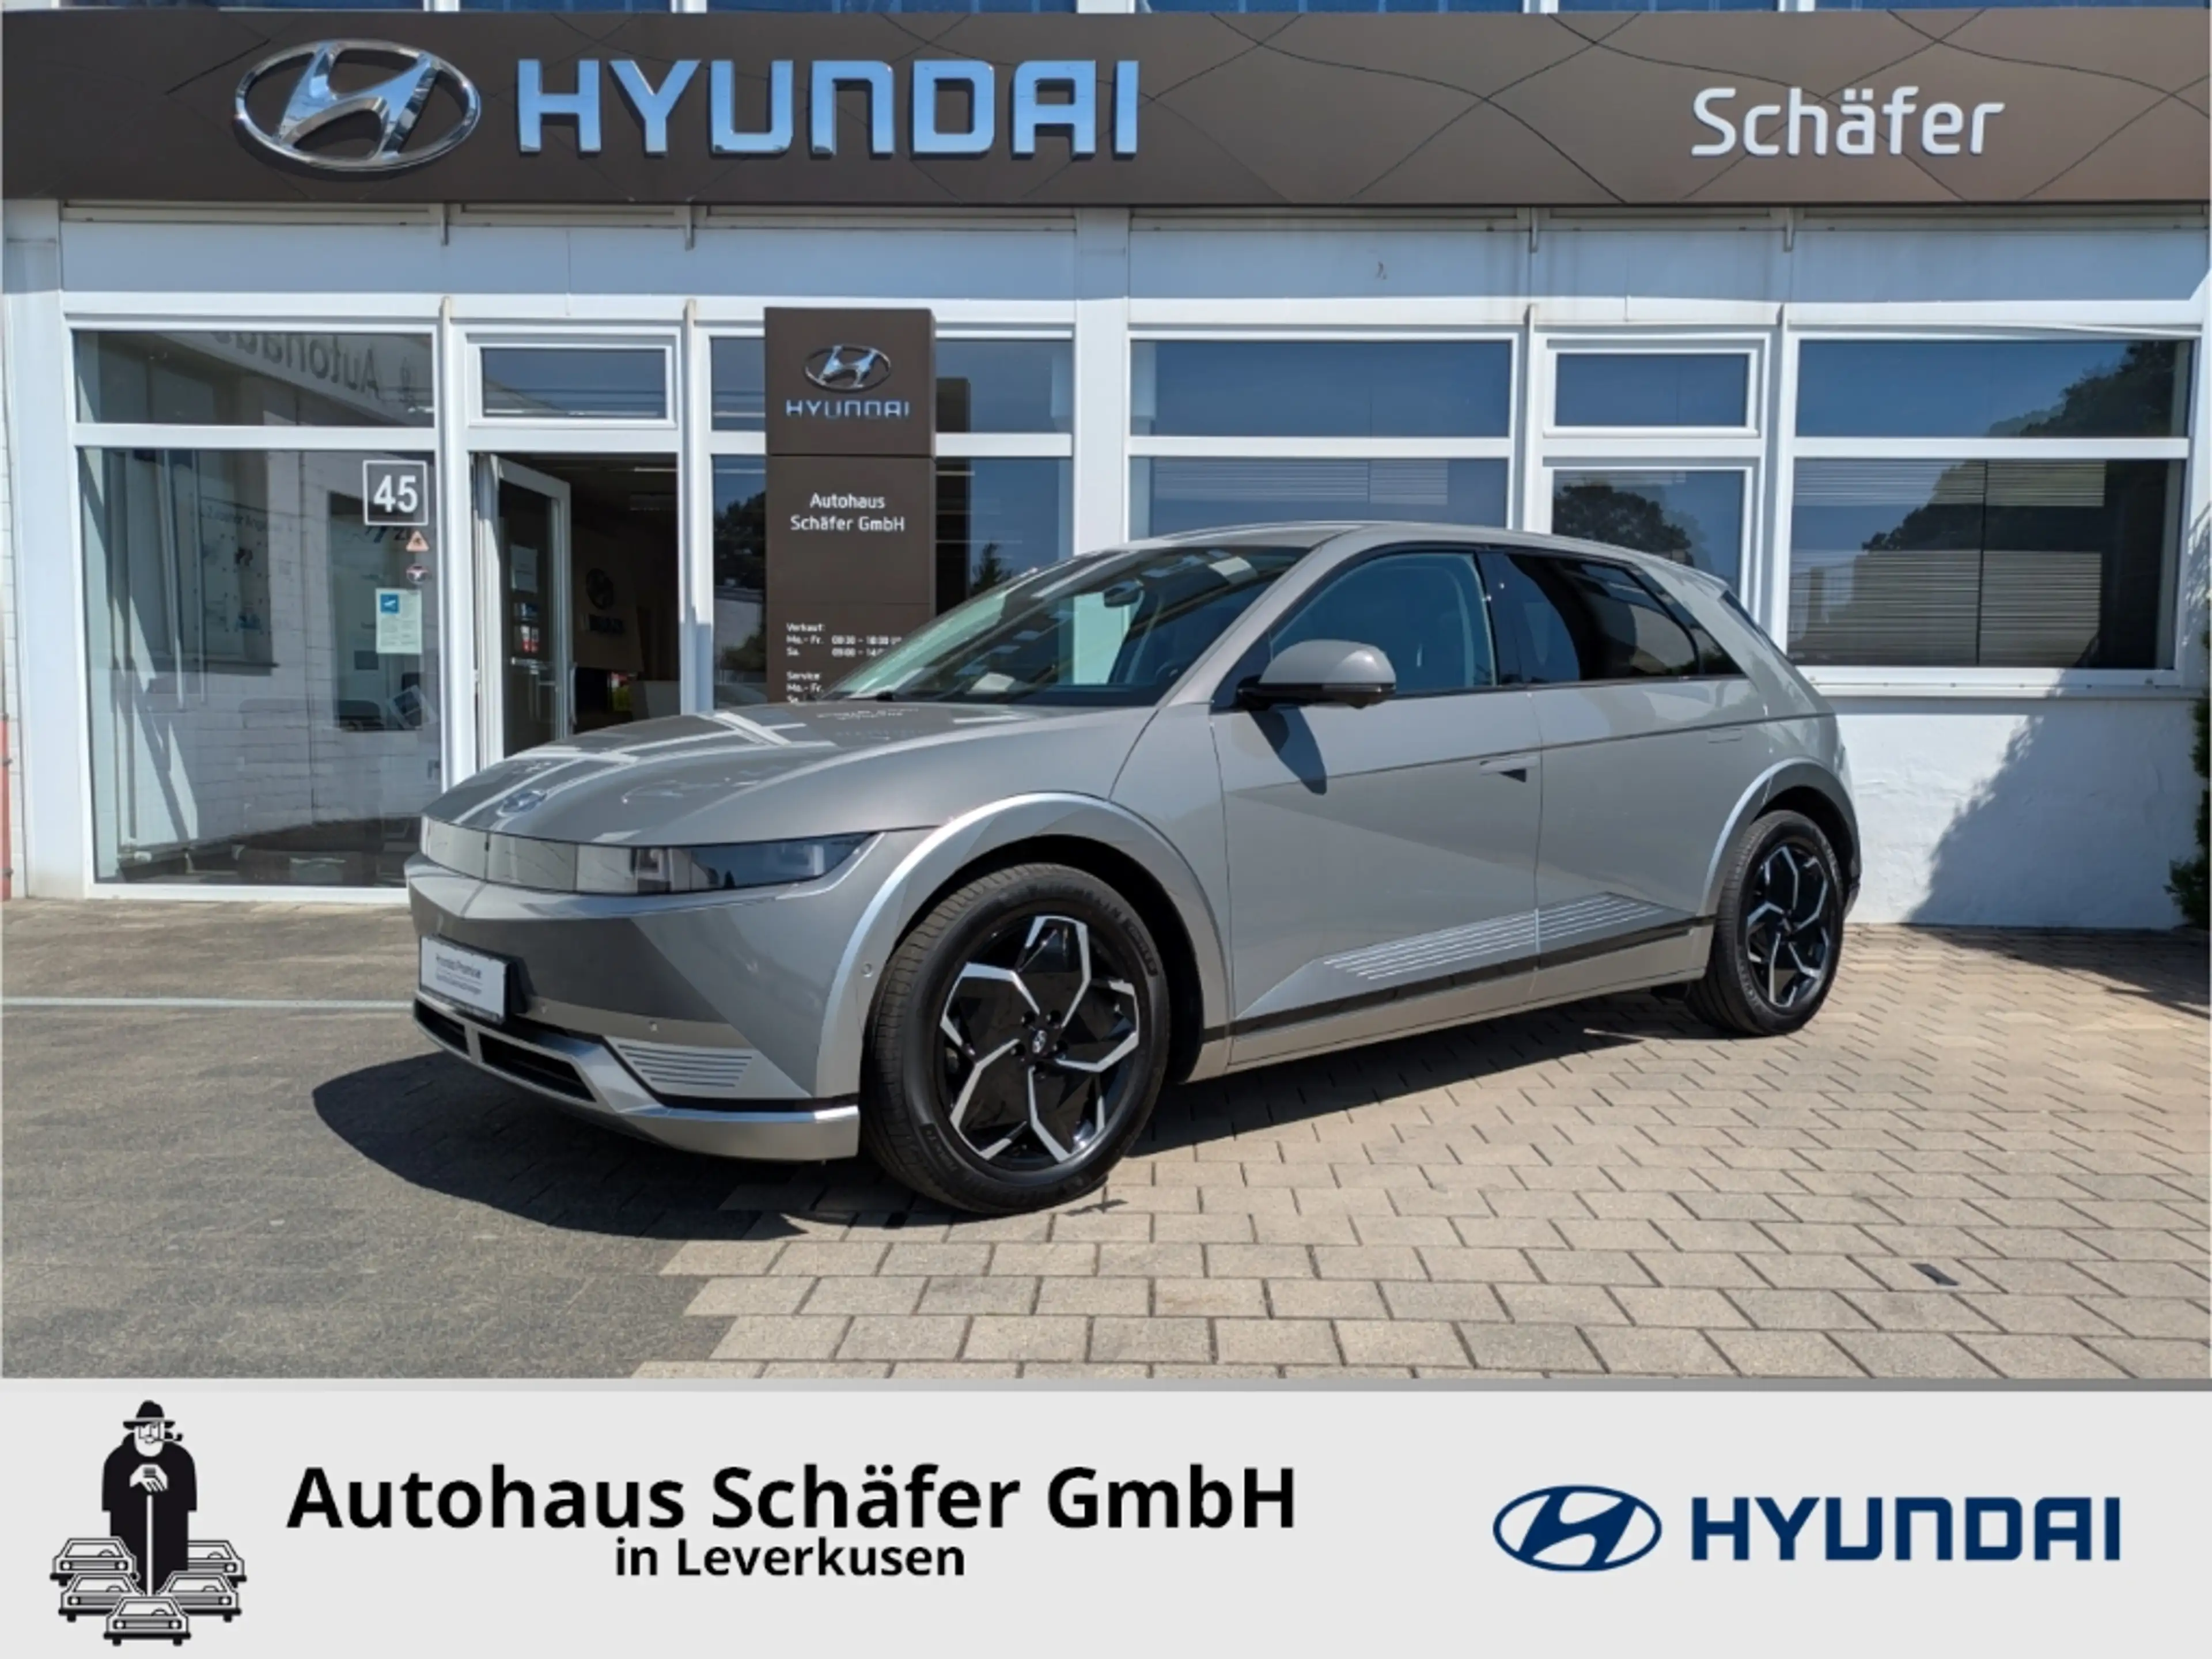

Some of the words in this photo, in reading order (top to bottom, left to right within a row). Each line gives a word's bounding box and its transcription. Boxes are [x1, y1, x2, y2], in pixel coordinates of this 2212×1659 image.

[517, 59, 1138, 156] HYUNDAI
[1692, 86, 2005, 156] Schäfer
[785, 399, 910, 418] HYUNDAI
[373, 475, 418, 512] 45
[809, 492, 886, 509] Autohaus
[790, 514, 854, 531] Schäfer
[858, 516, 905, 532] GmbH
